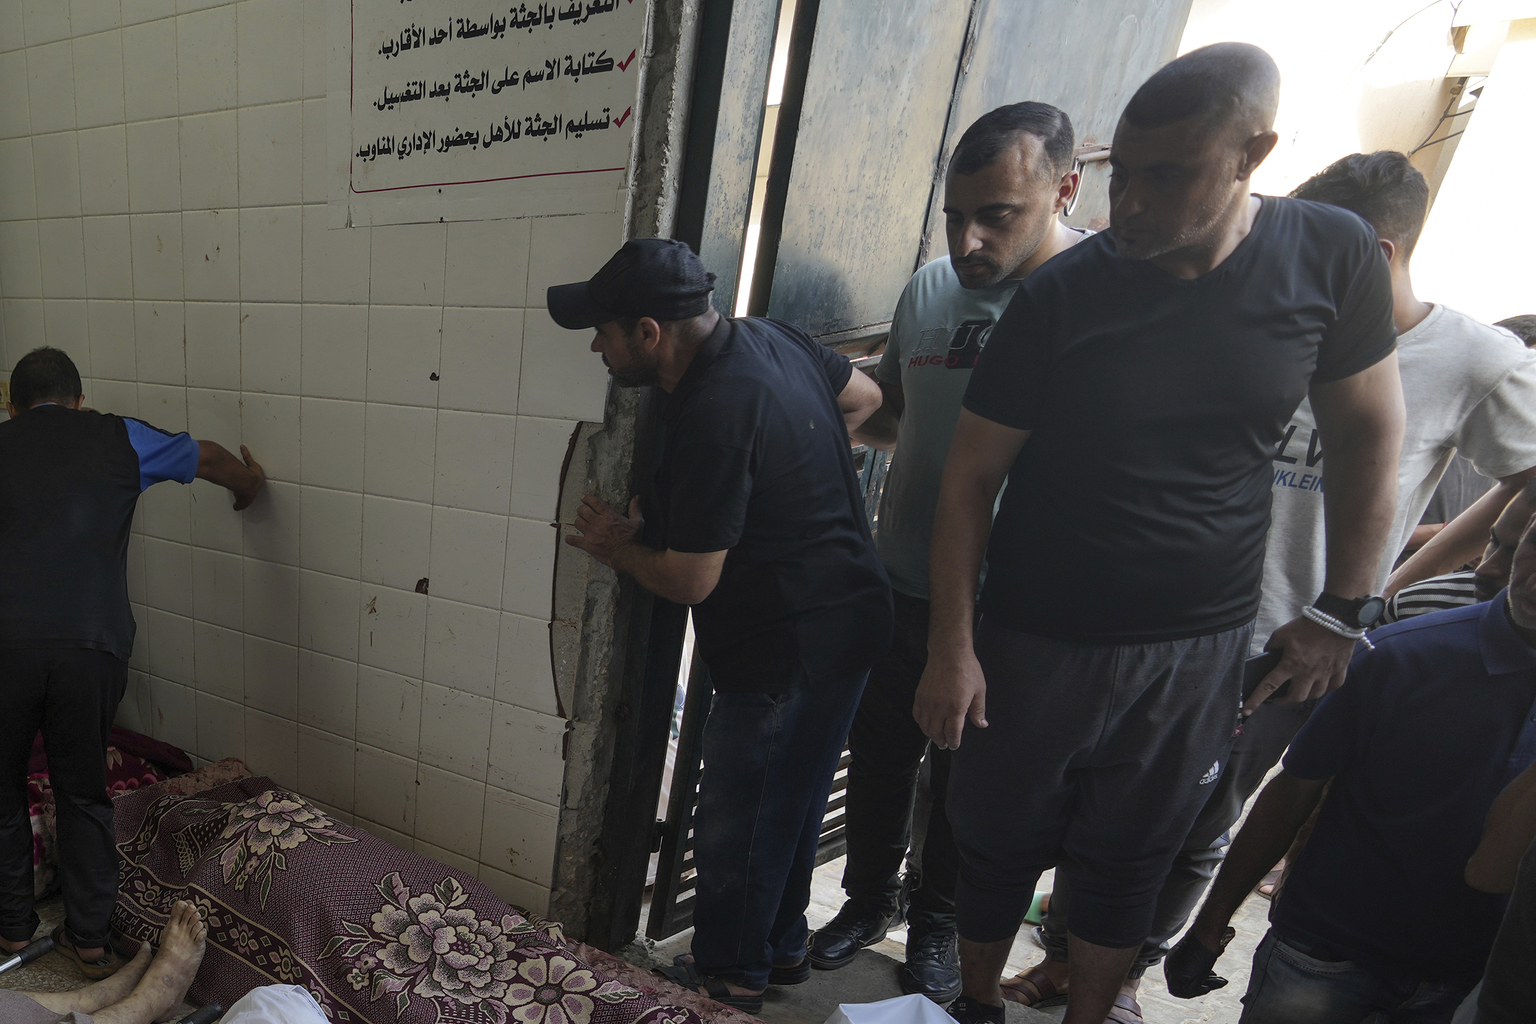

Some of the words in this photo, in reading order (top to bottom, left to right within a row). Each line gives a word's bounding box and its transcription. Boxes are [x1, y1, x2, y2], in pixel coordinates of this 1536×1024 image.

[428, 17, 453, 45] أحد
[456, 12, 507, 40] بواسطة
[509, 1, 555, 34] بالجثة
[377, 23, 426, 60] الأقارب.
[522, 58, 561, 92] الاسم
[564, 50, 615, 83] كتابة
[372, 81, 426, 111] التغسيل.
[429, 80, 451, 102] بعد
[454, 69, 489, 99] الجثة
[491, 69, 520, 94] على
[482, 118, 521, 149] للأهل
[524, 112, 563, 143] الجثة
[565, 108, 611, 140] تسليم
[355, 136, 395, 163] المناوب.
[397, 131, 436, 160] الإداري
[437, 127, 479, 153] بحضور
[908, 354, 960, 369] HUGO
[1199, 773, 1218, 785] adidas
